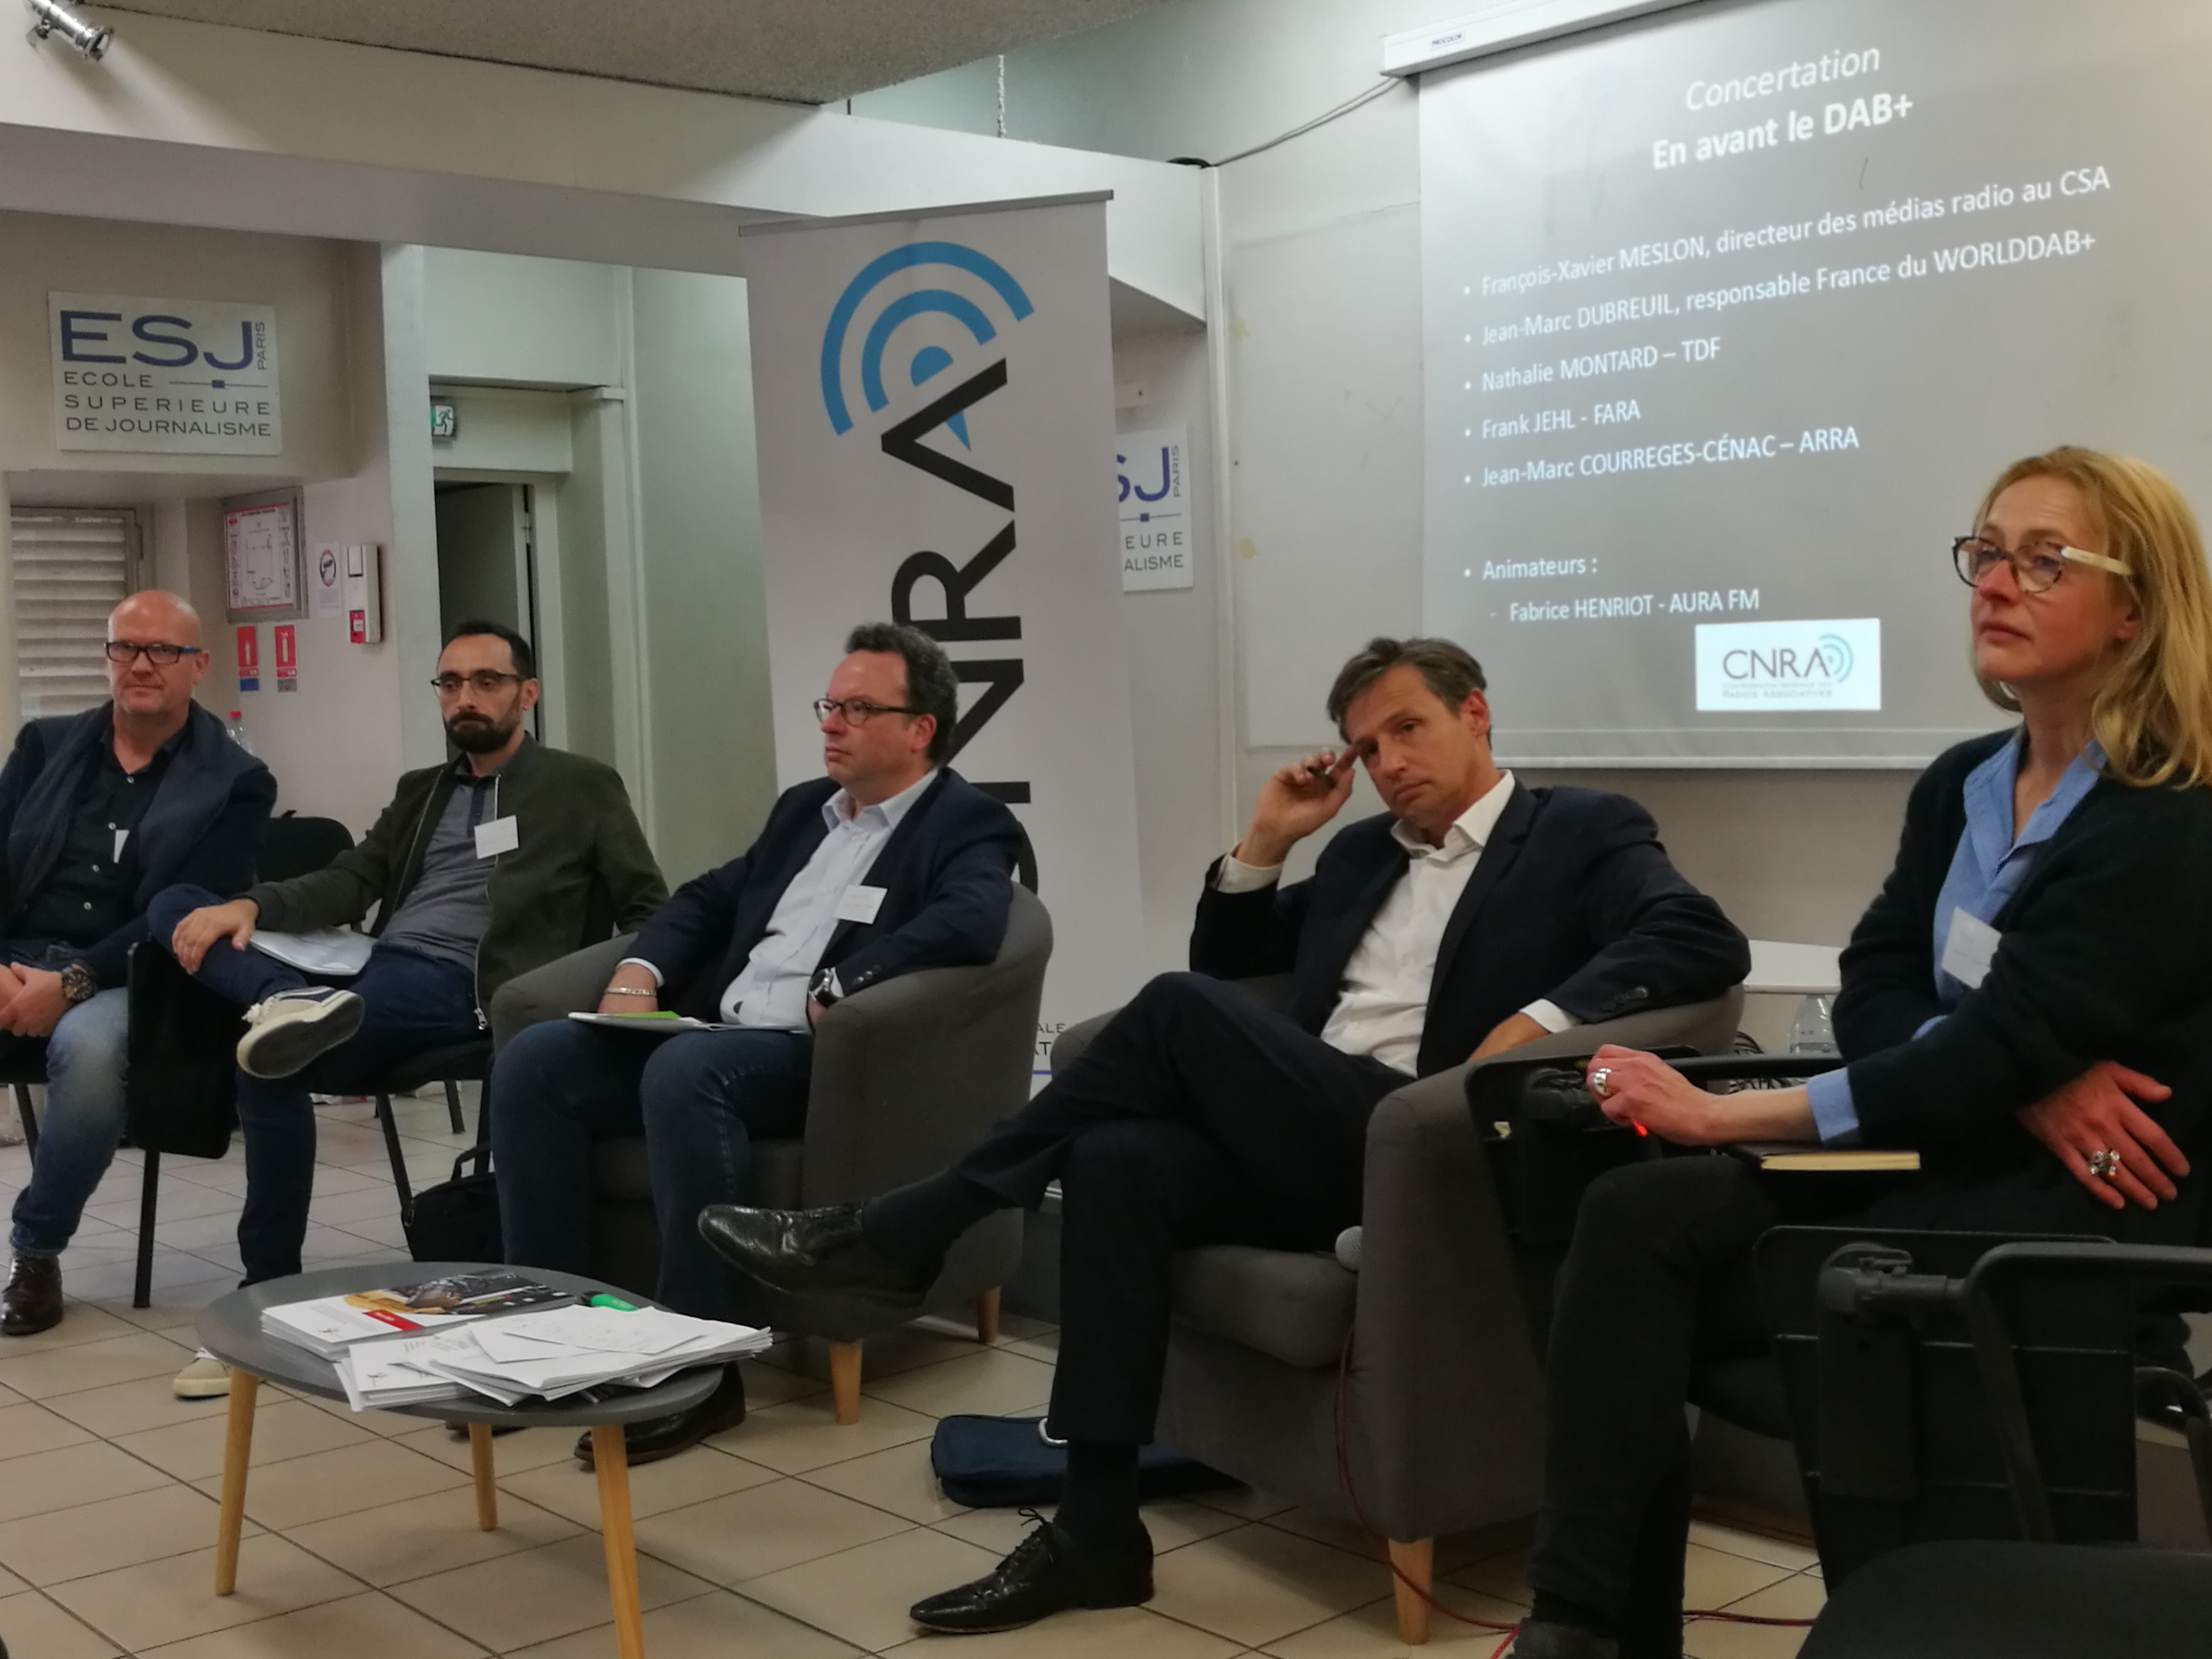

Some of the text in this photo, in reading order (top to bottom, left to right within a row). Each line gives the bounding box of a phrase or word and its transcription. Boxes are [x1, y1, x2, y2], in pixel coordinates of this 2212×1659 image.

[1687, 48, 1880, 110] Concertation
[1653, 93, 1913, 169] En avant le DAB+
[1483, 166, 2111, 295] François-Xavier MESLON, directeur des médias radio au CSA
[1483, 229, 2095, 345] Jean-Marc DUBREUIL, responsable France du WORLDDAB+
[60, 310, 254, 371] ESJ
[256, 321, 266, 371] PARIS
[1483, 363, 1554, 391] Nathalie
[1560, 346, 1658, 379] MONTARD
[1681, 336, 1720, 362] TDF
[64, 371, 153, 389] ECOLE
[65, 394, 271, 416] SUPERIEURE
[66, 417, 271, 437] DE JOURNALISME
[1483, 414, 1529, 439] Frank
[1534, 409, 1576, 433] JEHL
[1594, 399, 1641, 425] FARA
[1171, 445, 1181, 498] PARIS
[1482, 459, 1574, 487] Jean-Marc
[1579, 433, 1776, 476] COURREGES-CÉNAC
[1799, 425, 1860, 454] ARRA
[1482, 558, 1587, 580] Animateurs
[880, 357, 1039, 896] NRA
[1510, 601, 1570, 622] Fabrice
[1574, 594, 1654, 619] HENRIOT
[1668, 590, 1724, 614] AURA
[1728, 588, 1759, 610] FM
[1722, 648, 1831, 680] CNRA
